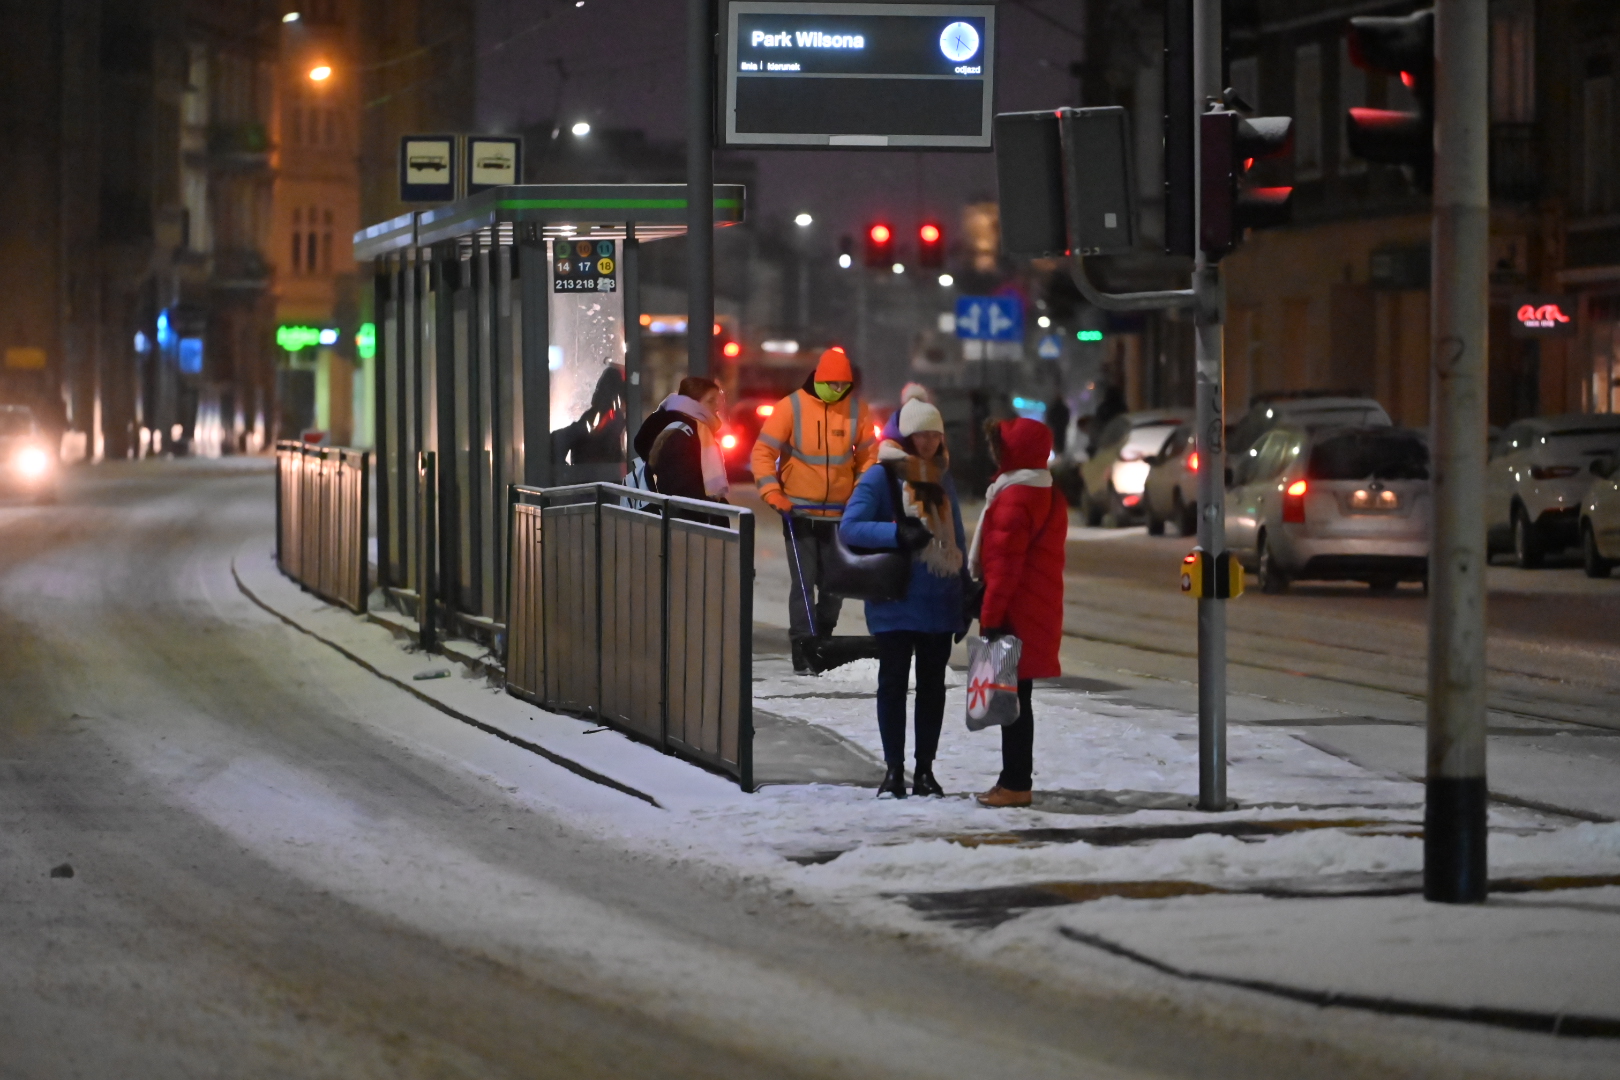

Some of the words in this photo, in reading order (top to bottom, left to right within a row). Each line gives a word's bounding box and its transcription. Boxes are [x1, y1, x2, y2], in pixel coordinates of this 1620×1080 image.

[751, 31, 792, 48] Park
[796, 31, 865, 49] Wilsona
[955, 65, 980, 75] odjazd
[579, 245, 589, 254] 10
[599, 245, 609, 253] 11
[557, 262, 569, 272] 14
[578, 262, 591, 271] 17
[600, 262, 611, 271] 18
[556, 279, 574, 289] 213
[576, 279, 594, 289] 218
